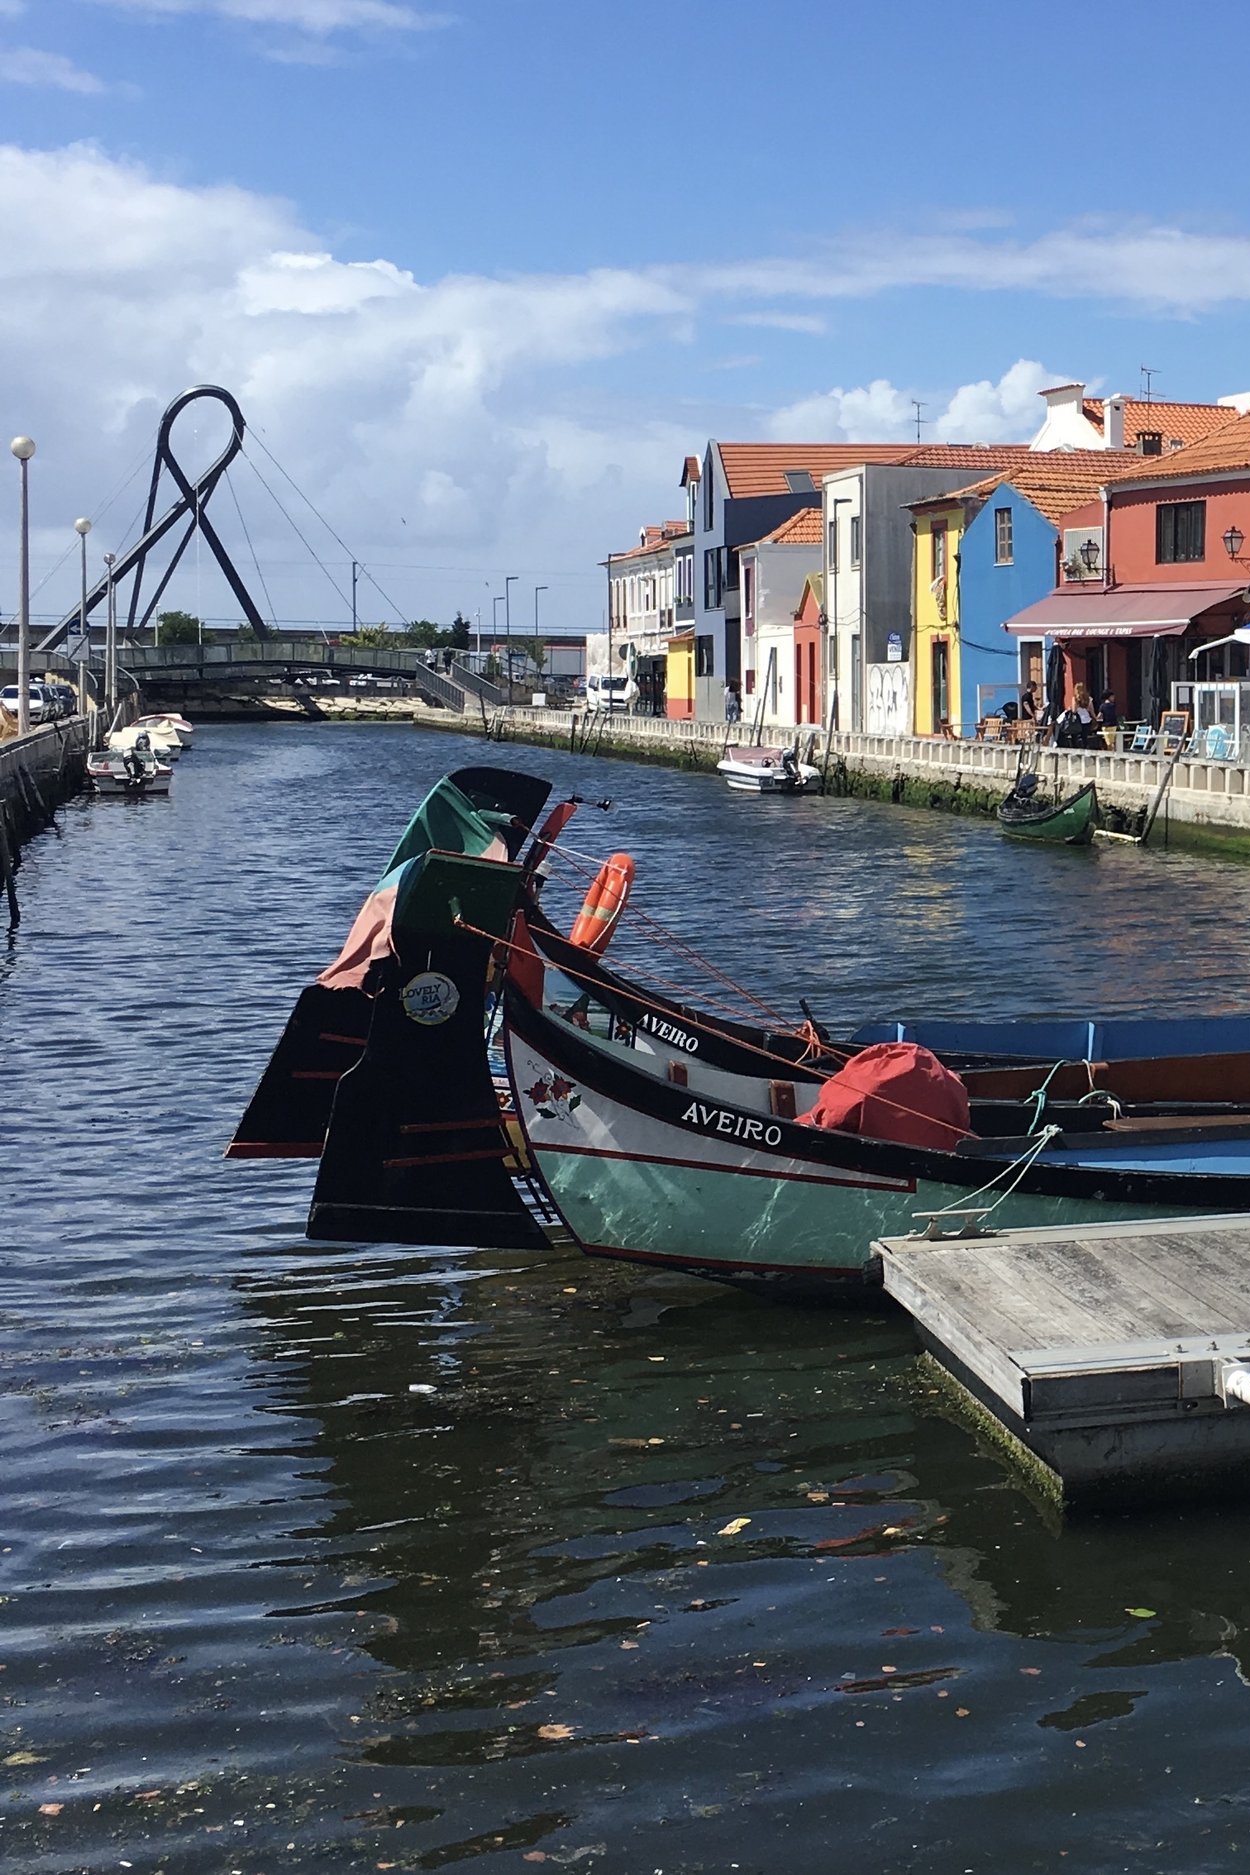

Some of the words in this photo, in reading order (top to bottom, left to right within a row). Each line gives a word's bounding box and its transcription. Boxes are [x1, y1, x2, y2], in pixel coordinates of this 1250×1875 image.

[398, 983, 441, 1000] LOVELY
[422, 993, 441, 1004] RIA
[636, 1013, 699, 1053] AVEIRO
[681, 1102, 782, 1146] AVEIRO
